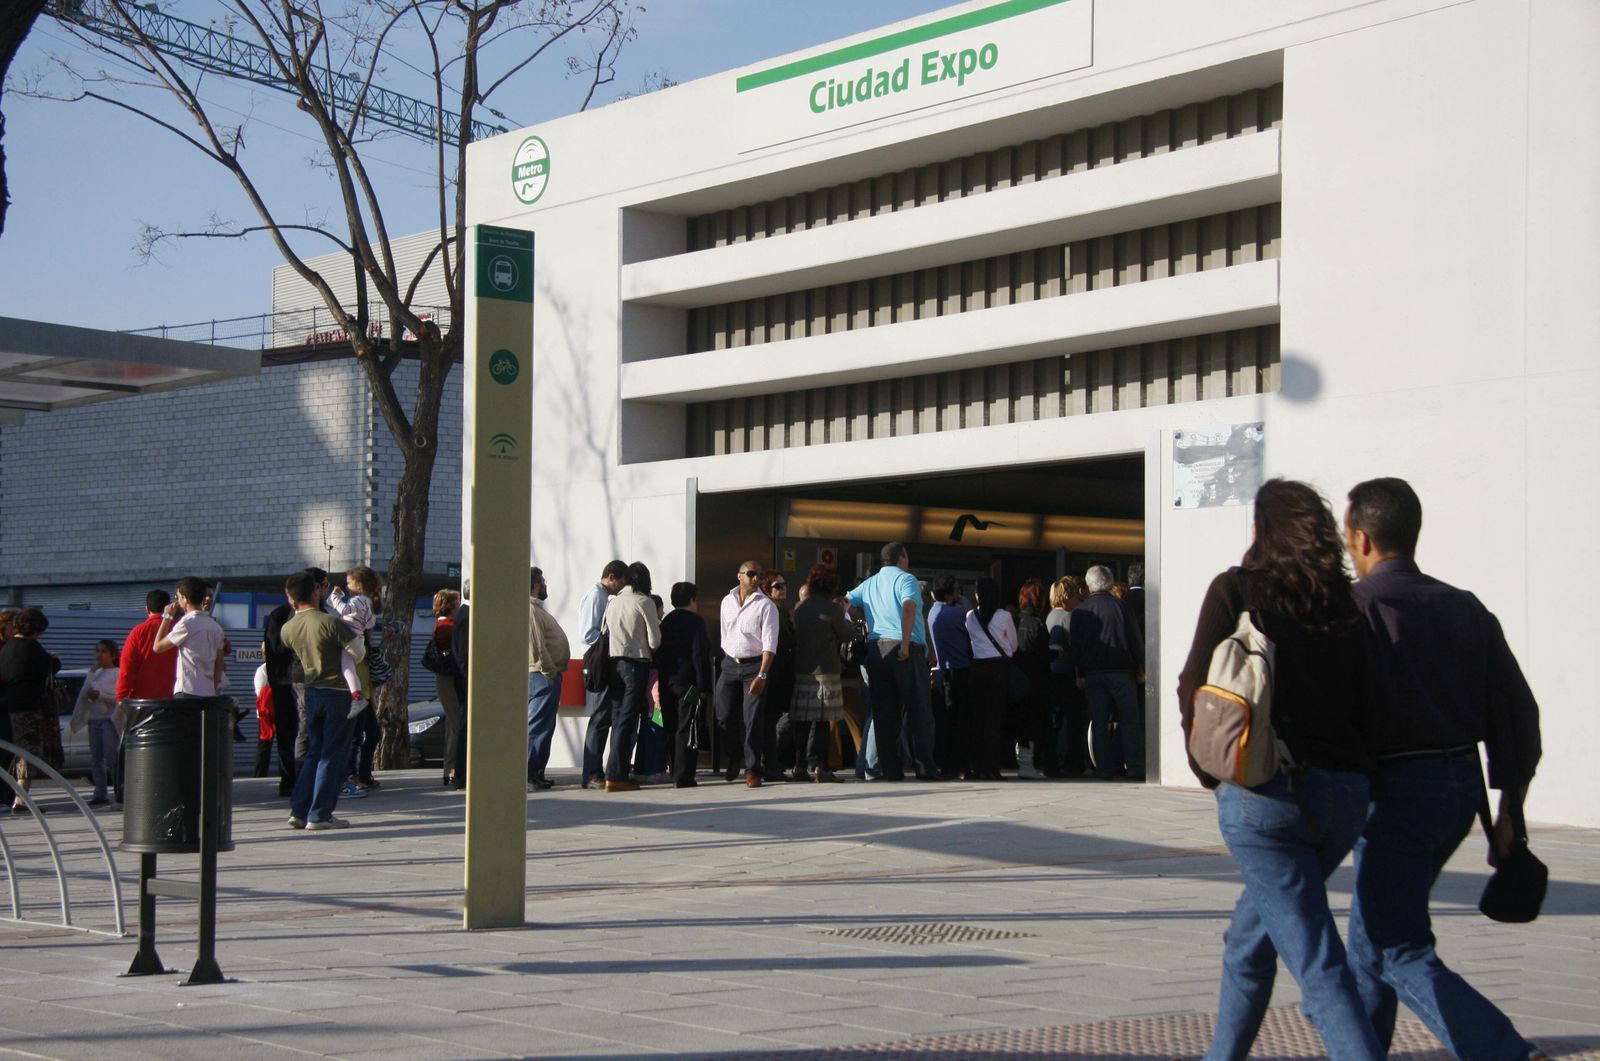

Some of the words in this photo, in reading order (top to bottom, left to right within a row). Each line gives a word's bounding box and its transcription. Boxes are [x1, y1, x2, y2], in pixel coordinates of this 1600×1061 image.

[810, 58, 909, 113] Ciudad
[921, 43, 998, 86] Expo
[518, 164, 543, 179] Metro
[238, 650, 264, 660] INAB
